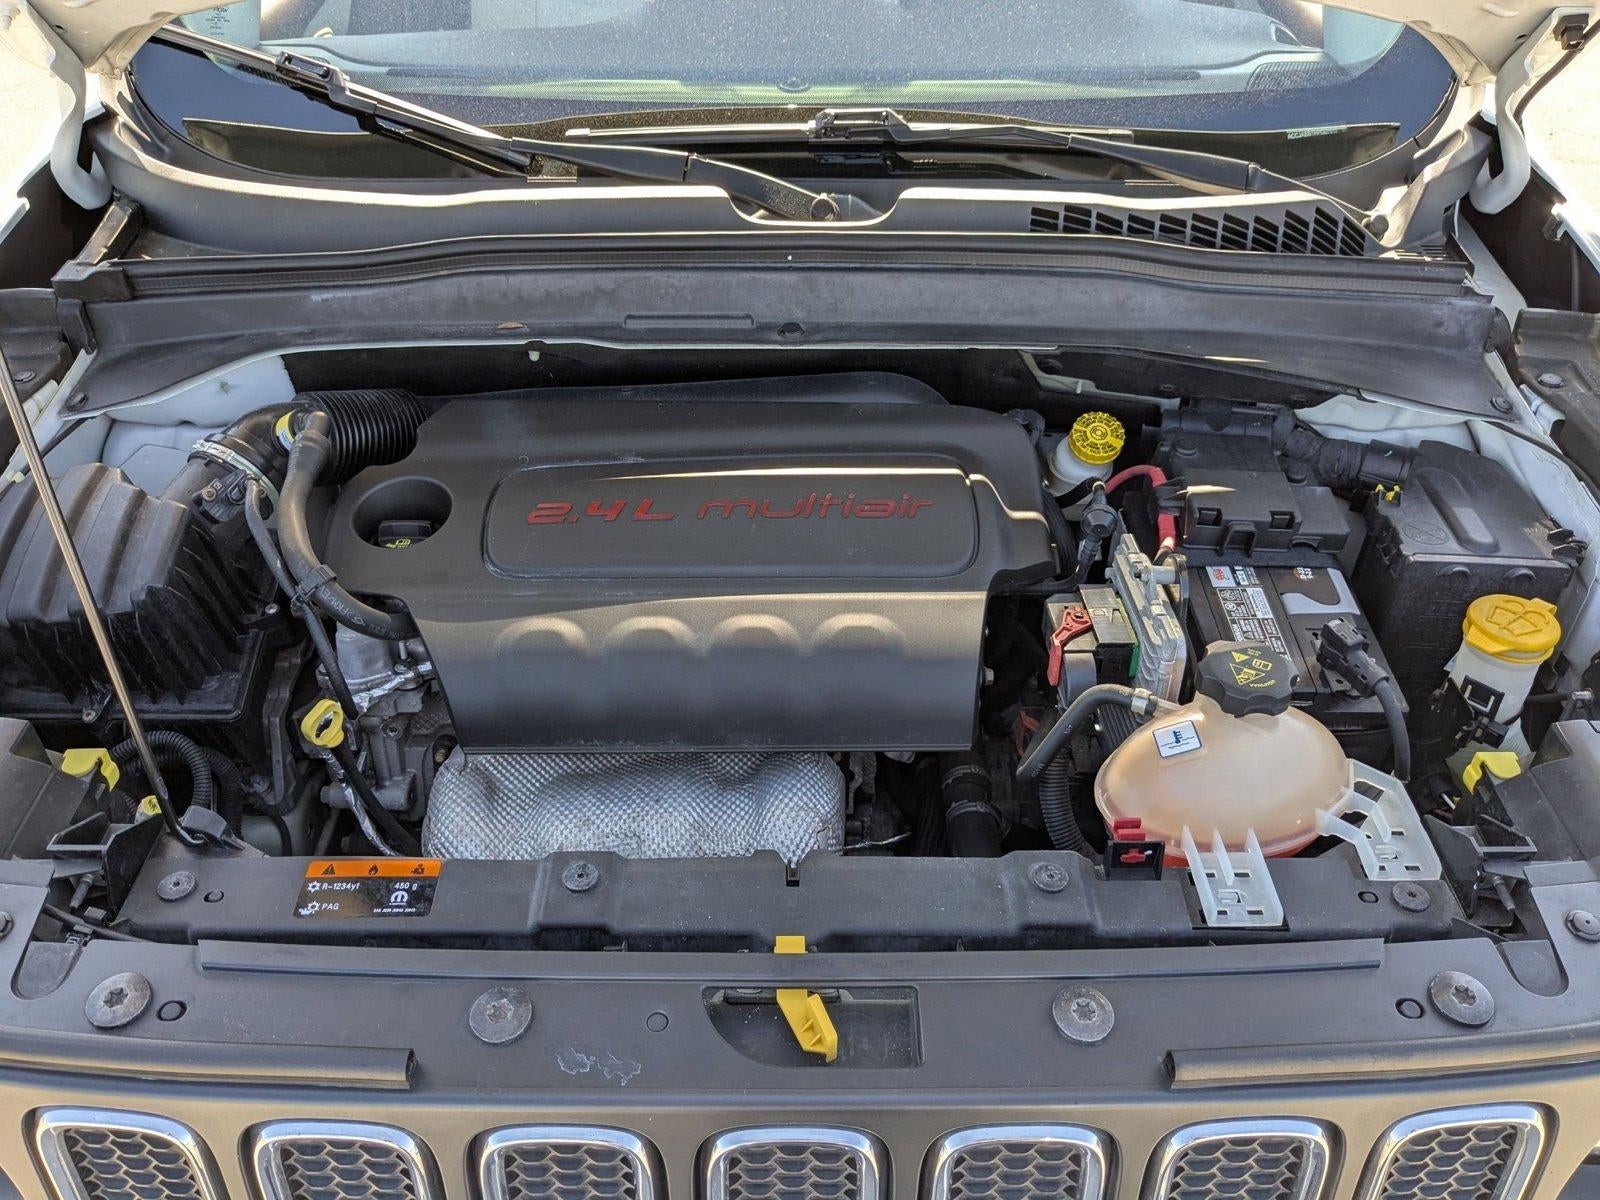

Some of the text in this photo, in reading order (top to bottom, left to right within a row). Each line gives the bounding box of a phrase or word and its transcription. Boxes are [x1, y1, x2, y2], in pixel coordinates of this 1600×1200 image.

[697, 493, 934, 519] multiair
[321, 882, 360, 891] R-1234yf
[411, 882, 418, 891] g
[321, 902, 340, 910] PAG
